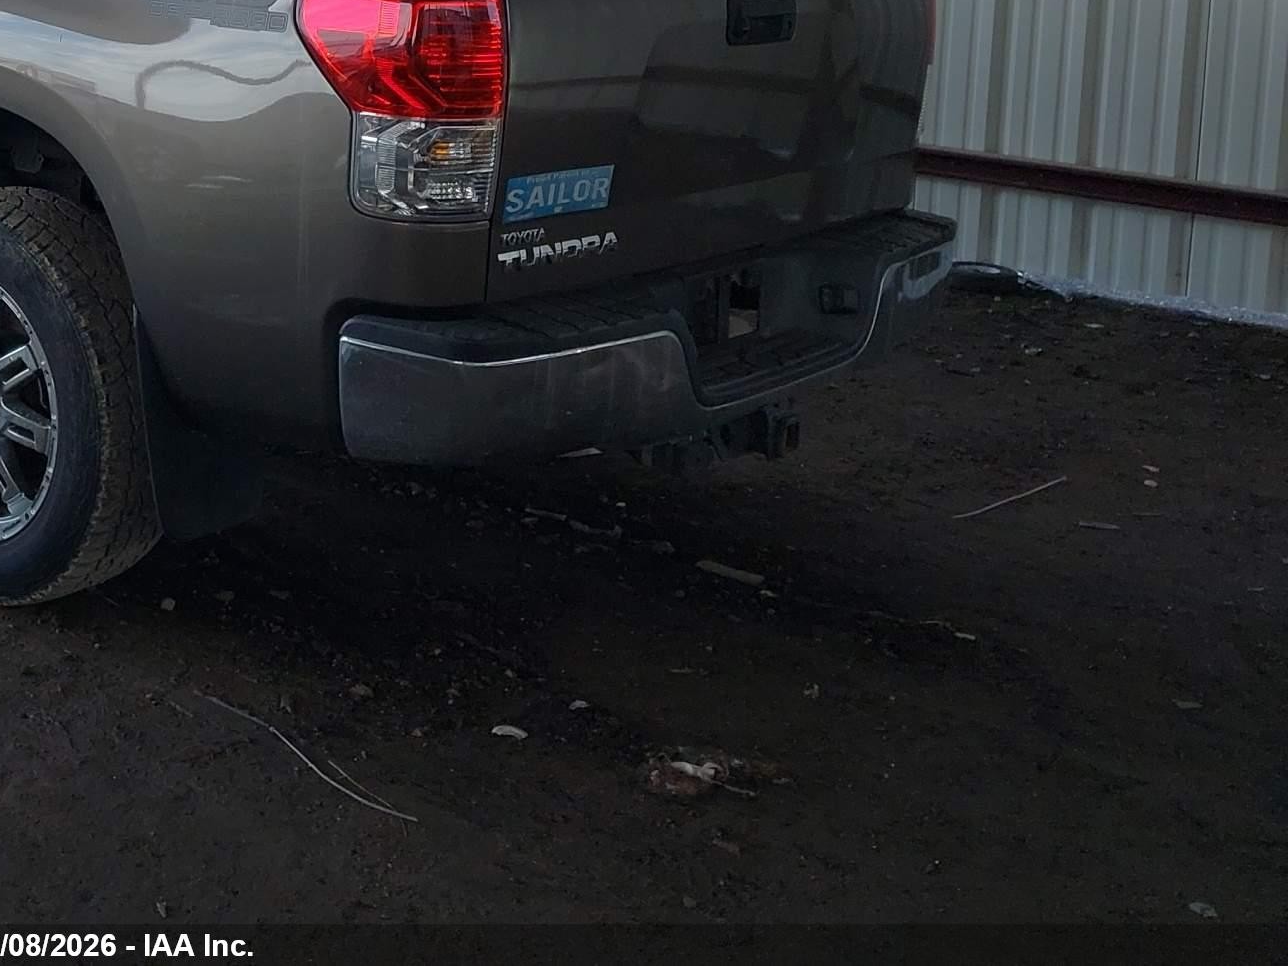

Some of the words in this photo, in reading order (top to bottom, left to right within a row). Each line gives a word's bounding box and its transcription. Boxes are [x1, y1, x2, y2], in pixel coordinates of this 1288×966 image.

[505, 177, 610, 213] SAILOR
[497, 231, 618, 268] TUNDRA
[501, 227, 545, 246] TOYOTA
